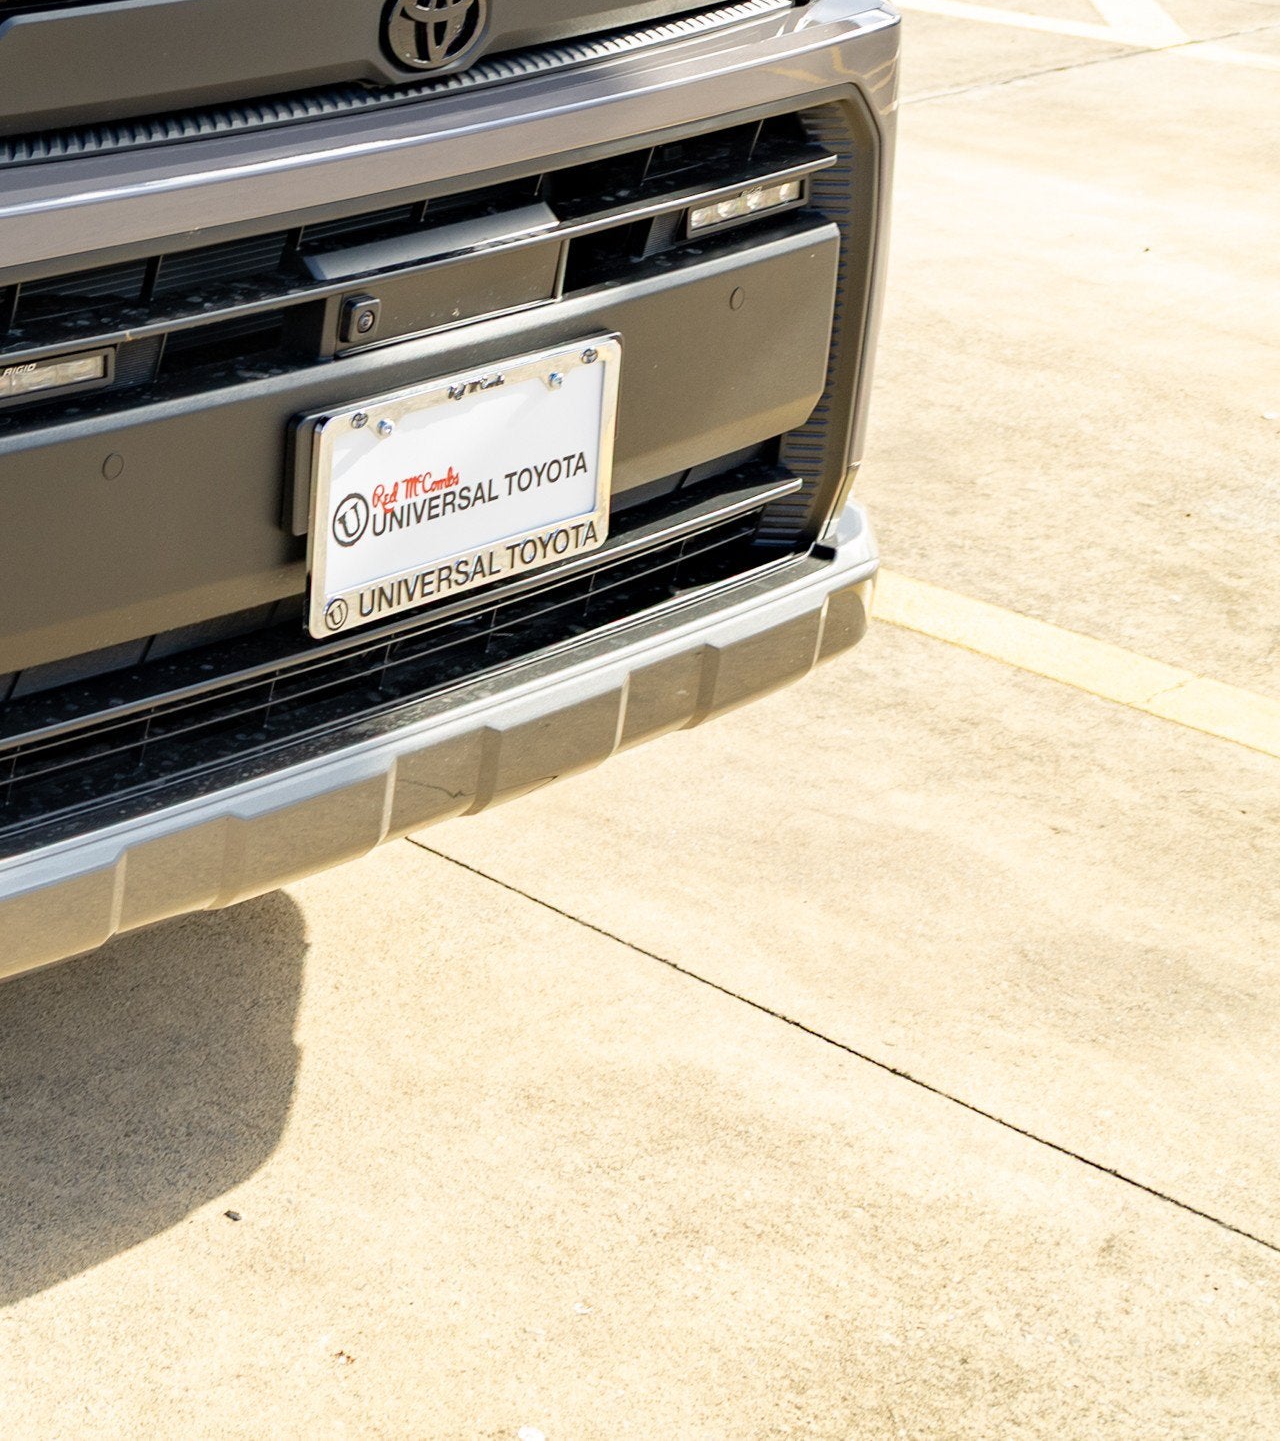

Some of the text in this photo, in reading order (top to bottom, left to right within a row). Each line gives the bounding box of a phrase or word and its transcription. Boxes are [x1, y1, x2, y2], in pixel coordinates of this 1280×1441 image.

[372, 477, 499, 537] UNIVERSAL
[504, 451, 588, 496] TOYOTA
[372, 477, 399, 515] Red
[359, 553, 502, 617] UNIVERSAL
[506, 520, 598, 570] TOYOTA
